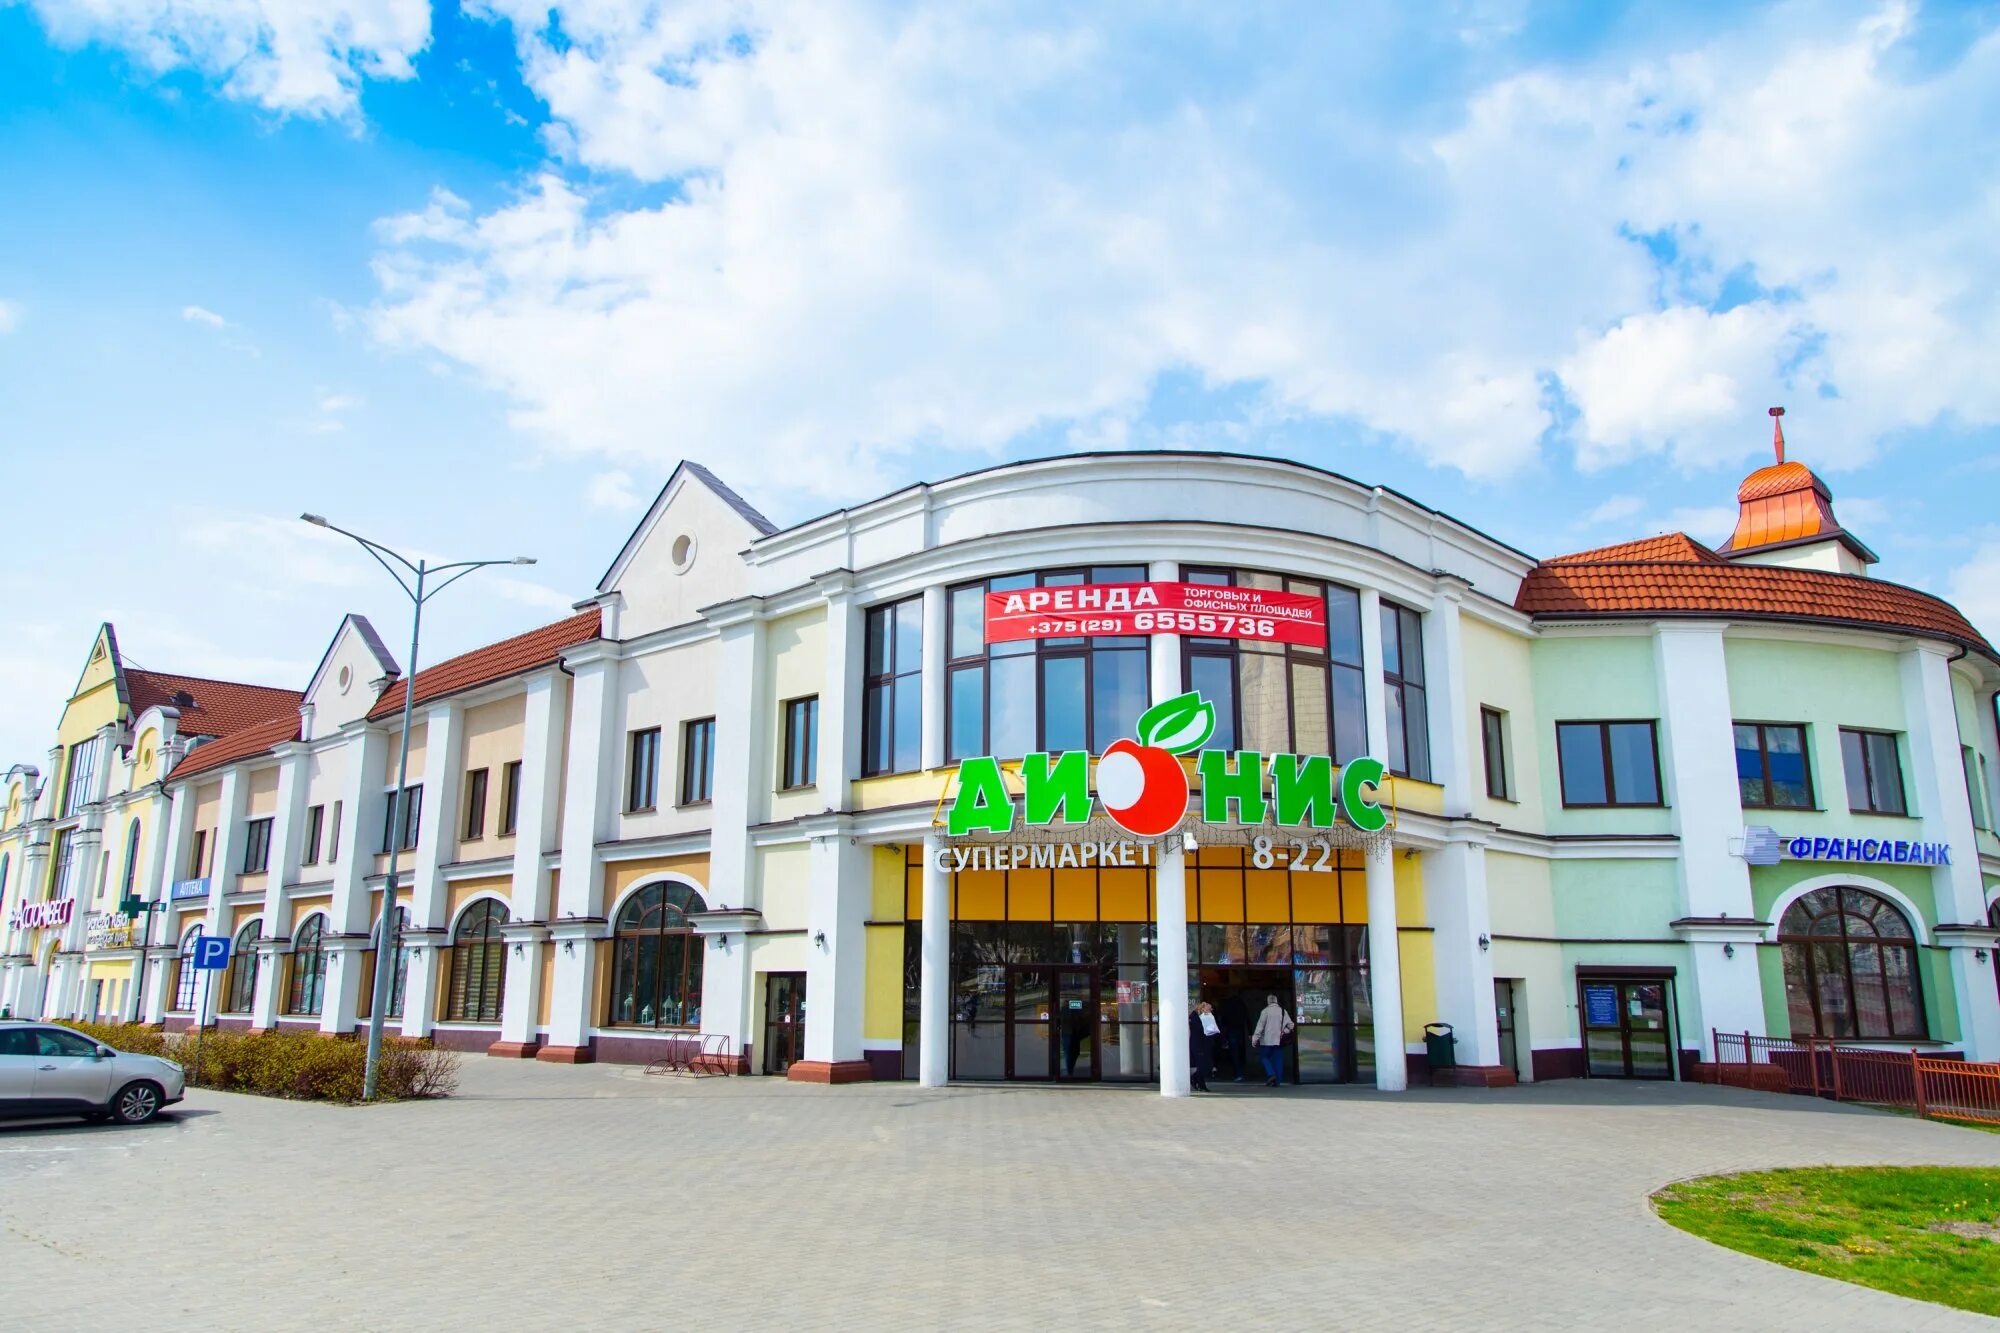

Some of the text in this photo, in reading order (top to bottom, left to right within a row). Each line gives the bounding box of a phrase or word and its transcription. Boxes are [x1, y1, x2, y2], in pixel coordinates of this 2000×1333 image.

[1004, 587, 1159, 614] АРЕНДА
[1184, 587, 1261, 603] ТОРГОВЫХ И
[1184, 599, 1313, 619] ОФИСНЫХ ПЛОЩАДЕЙ
[1028, 613, 1275, 637] +375 (29) 6555736
[934, 834, 1334, 874] СУПЕРМАРКЕТ 8-22
[1788, 836, 1951, 865] ФРАНСАБАНК
[180, 880, 203, 896] АПТЕКА
[204, 941, 224, 965] P
